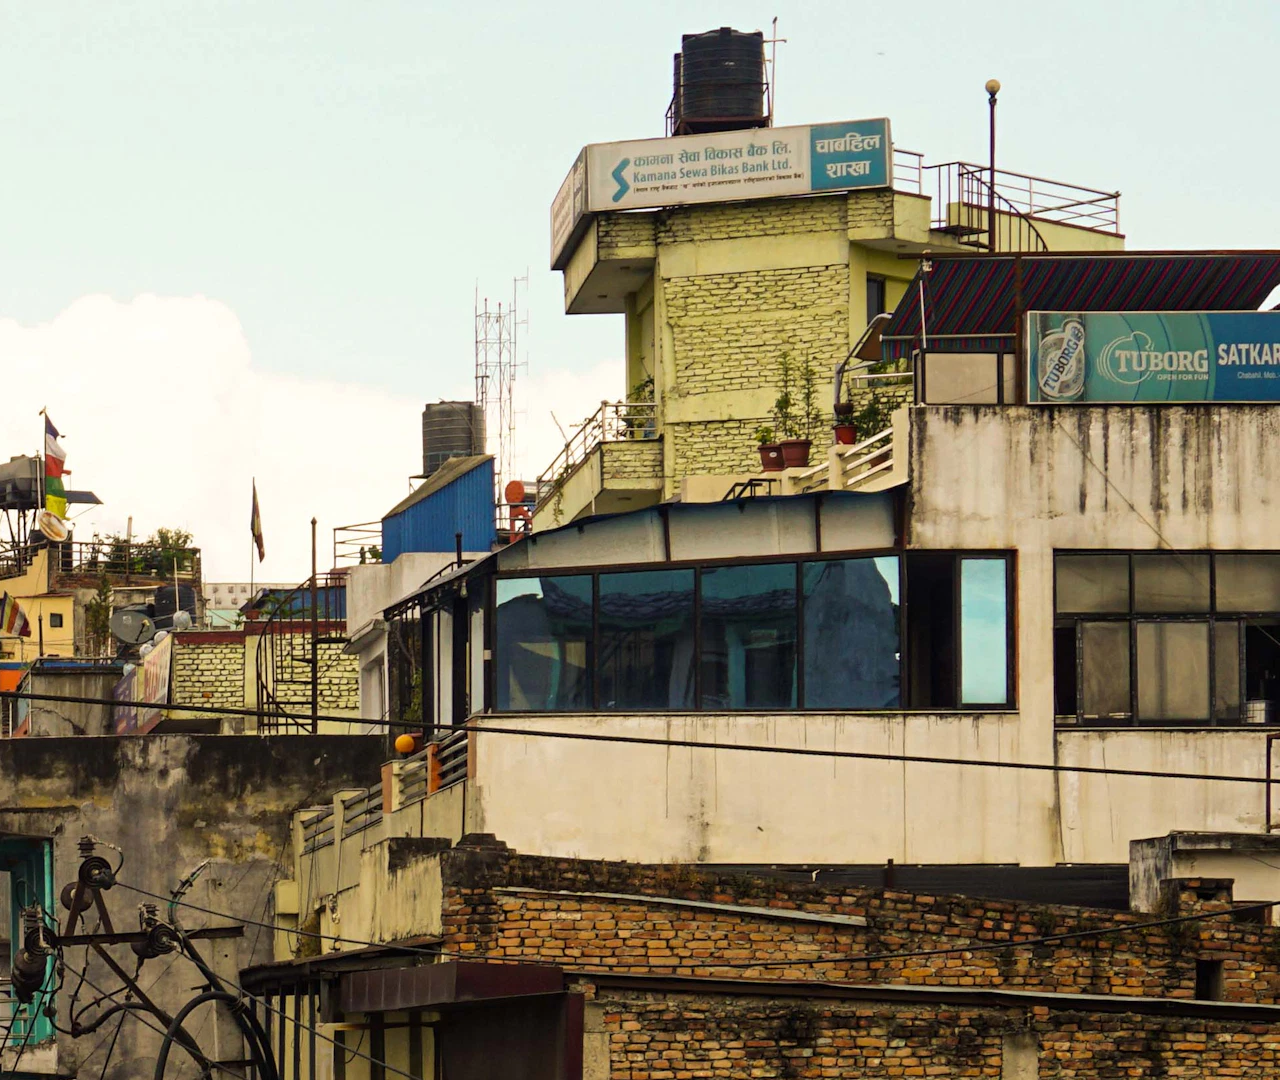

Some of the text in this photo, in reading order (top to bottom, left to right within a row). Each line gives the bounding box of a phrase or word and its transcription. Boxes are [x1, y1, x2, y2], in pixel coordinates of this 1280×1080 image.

[633, 152, 674, 167] कामना
[678, 148, 701, 165] सेवा
[704, 145, 743, 163] विकास
[771, 140, 792, 155] लि.
[815, 133, 880, 154] चाबहिल
[633, 158, 792, 184] Kamana Sewa Bikas Bank Ltd.
[825, 160, 871, 178] शाखा
[1043, 338, 1080, 391] TUBORG
[1115, 349, 1209, 373] TUBORG
